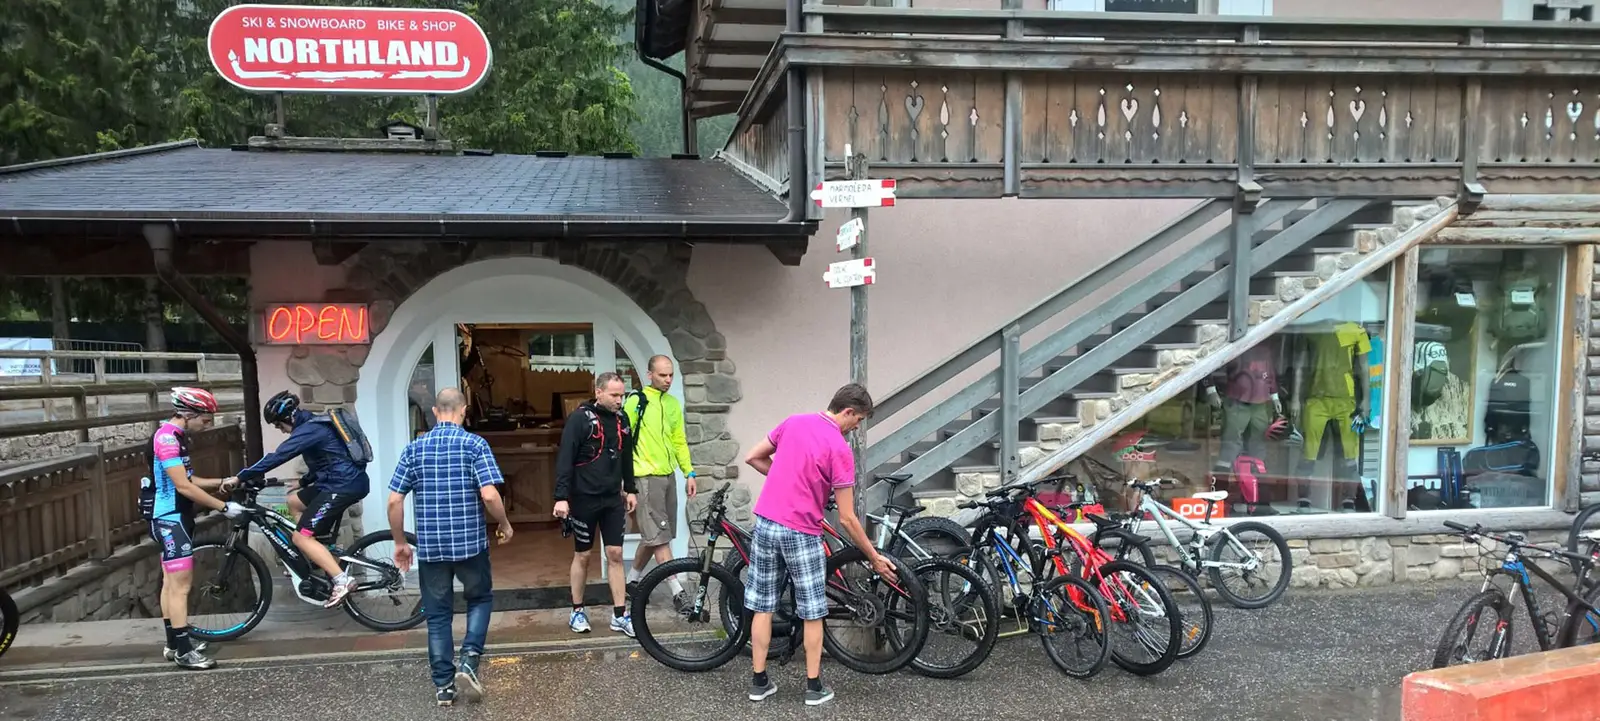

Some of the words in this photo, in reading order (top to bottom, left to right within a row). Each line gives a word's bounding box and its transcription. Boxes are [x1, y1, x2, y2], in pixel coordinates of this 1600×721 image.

[242, 17, 262, 28] SKI
[267, 18, 276, 28] &
[280, 18, 366, 30] SNOWBOARD
[377, 20, 405, 31] BIKE
[409, 20, 419, 31] &
[422, 20, 457, 32] SHOP
[243, 37, 459, 66] NORTHLAND
[269, 305, 364, 344] OPEN
